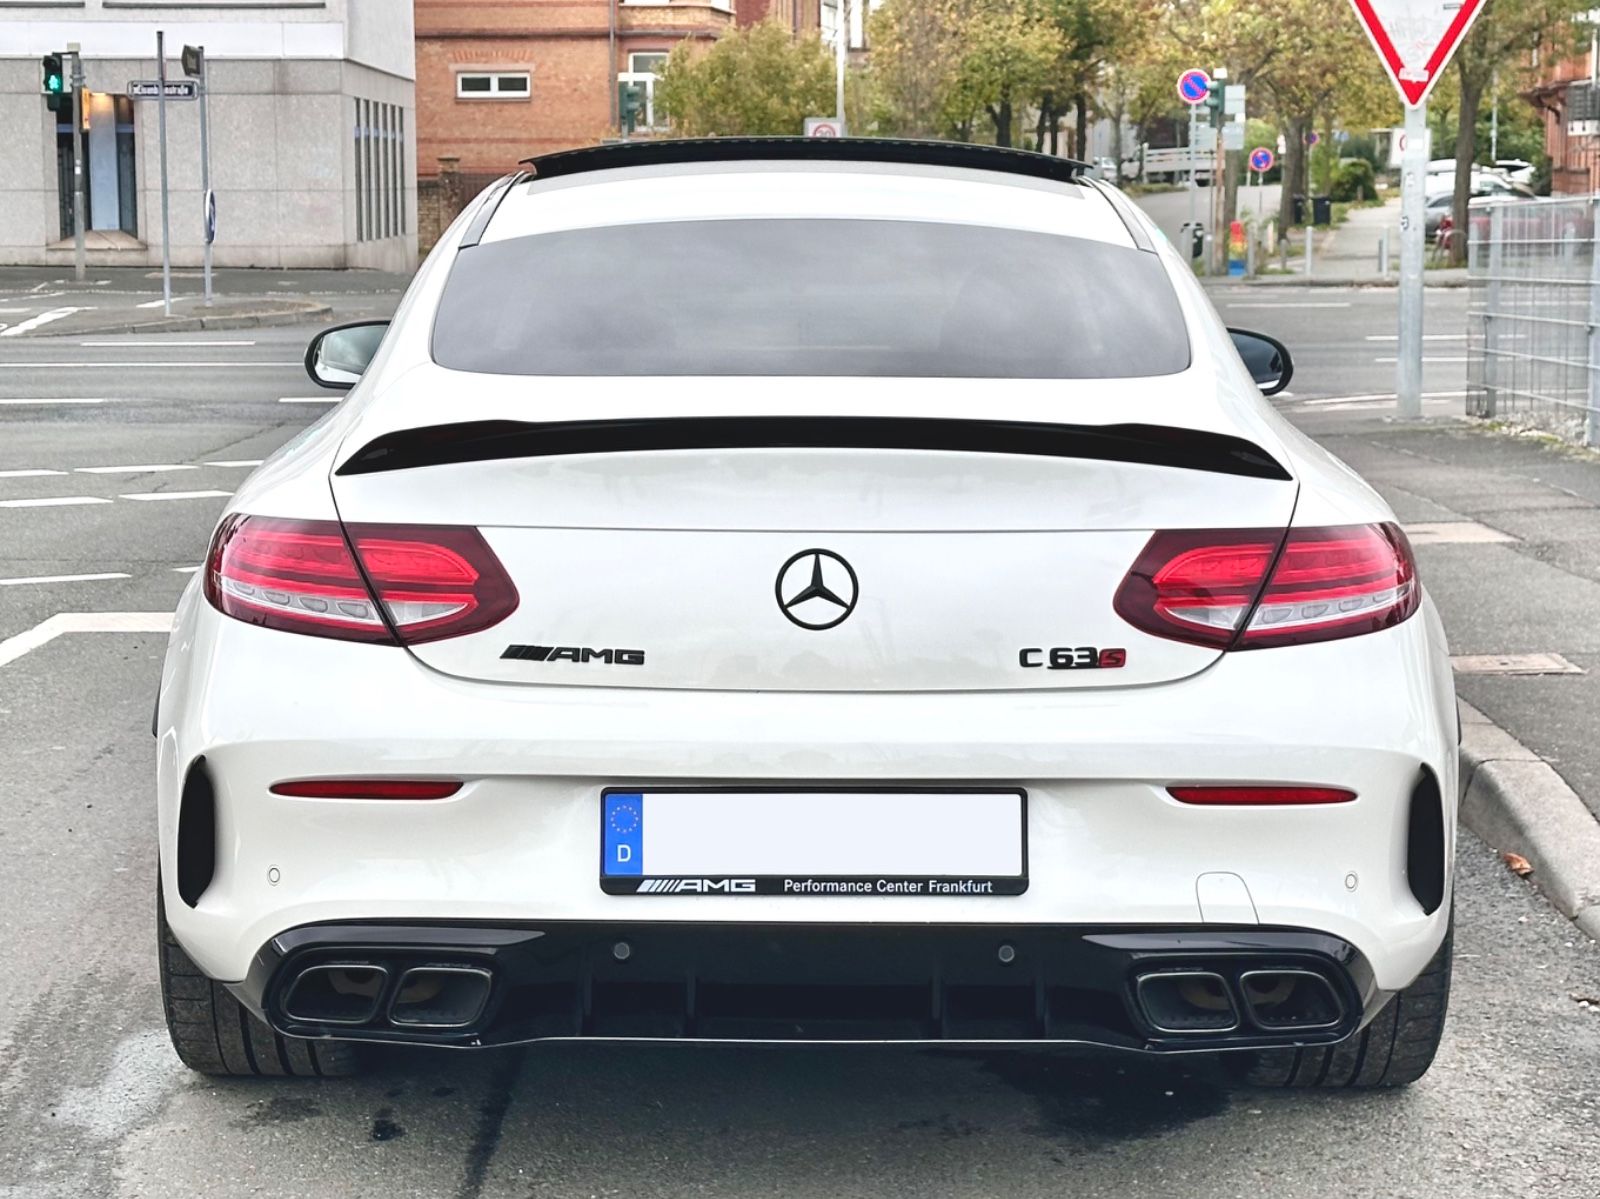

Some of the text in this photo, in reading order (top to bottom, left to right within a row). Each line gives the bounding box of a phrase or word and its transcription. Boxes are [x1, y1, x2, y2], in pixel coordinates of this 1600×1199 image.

[547, 647, 645, 665] AMG
[1019, 648, 1043, 668] C
[617, 844, 632, 862] D
[674, 879, 993, 894] AMG Performance Center Frankfurt
